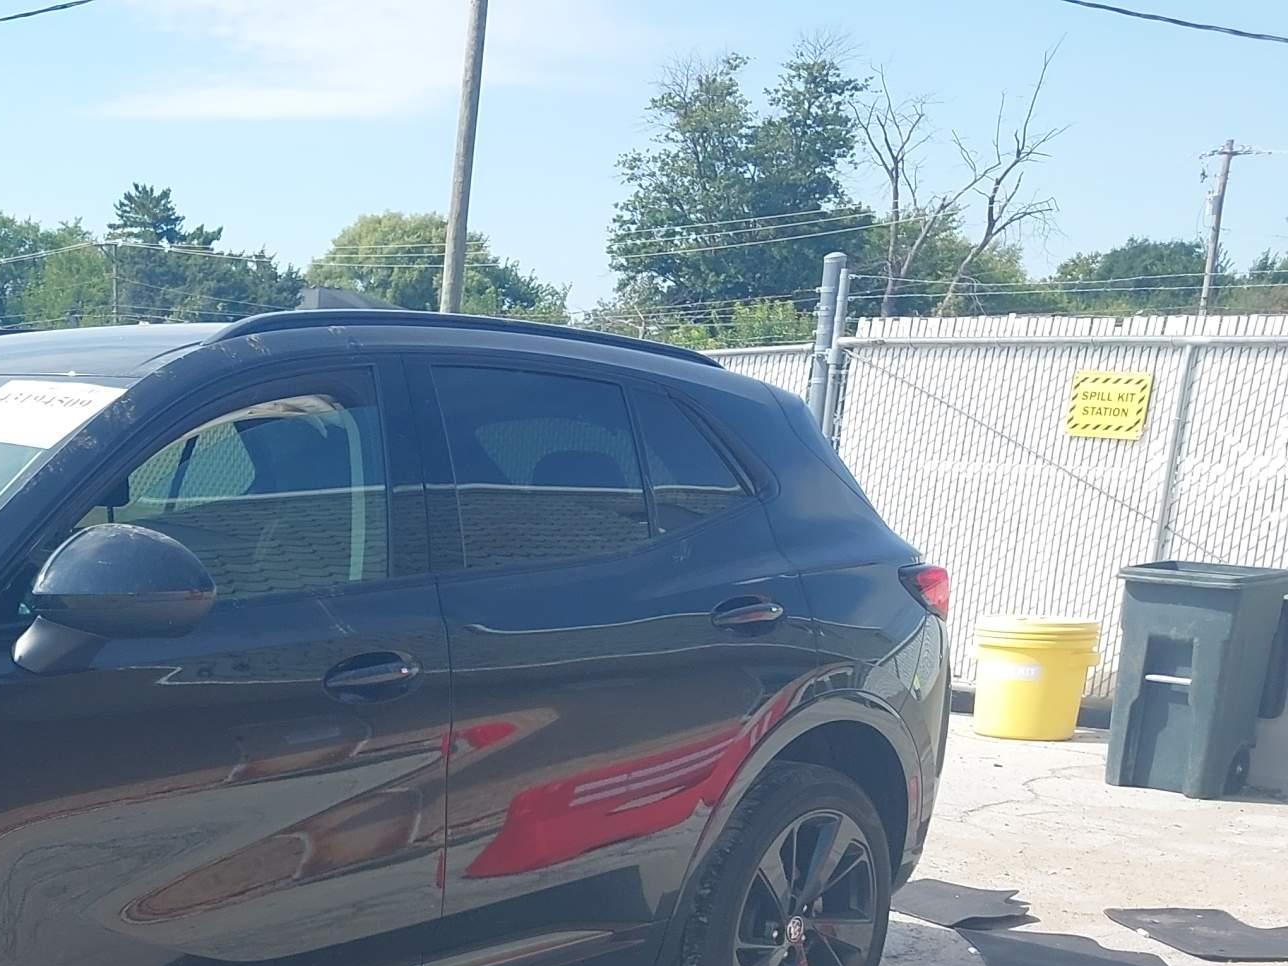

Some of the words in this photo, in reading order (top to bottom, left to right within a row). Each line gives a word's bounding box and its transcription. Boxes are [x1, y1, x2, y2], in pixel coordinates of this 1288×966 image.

[1081, 391, 1112, 401] SPILL
[1117, 392, 1136, 402] KIT
[1081, 406, 1129, 417] STATION
